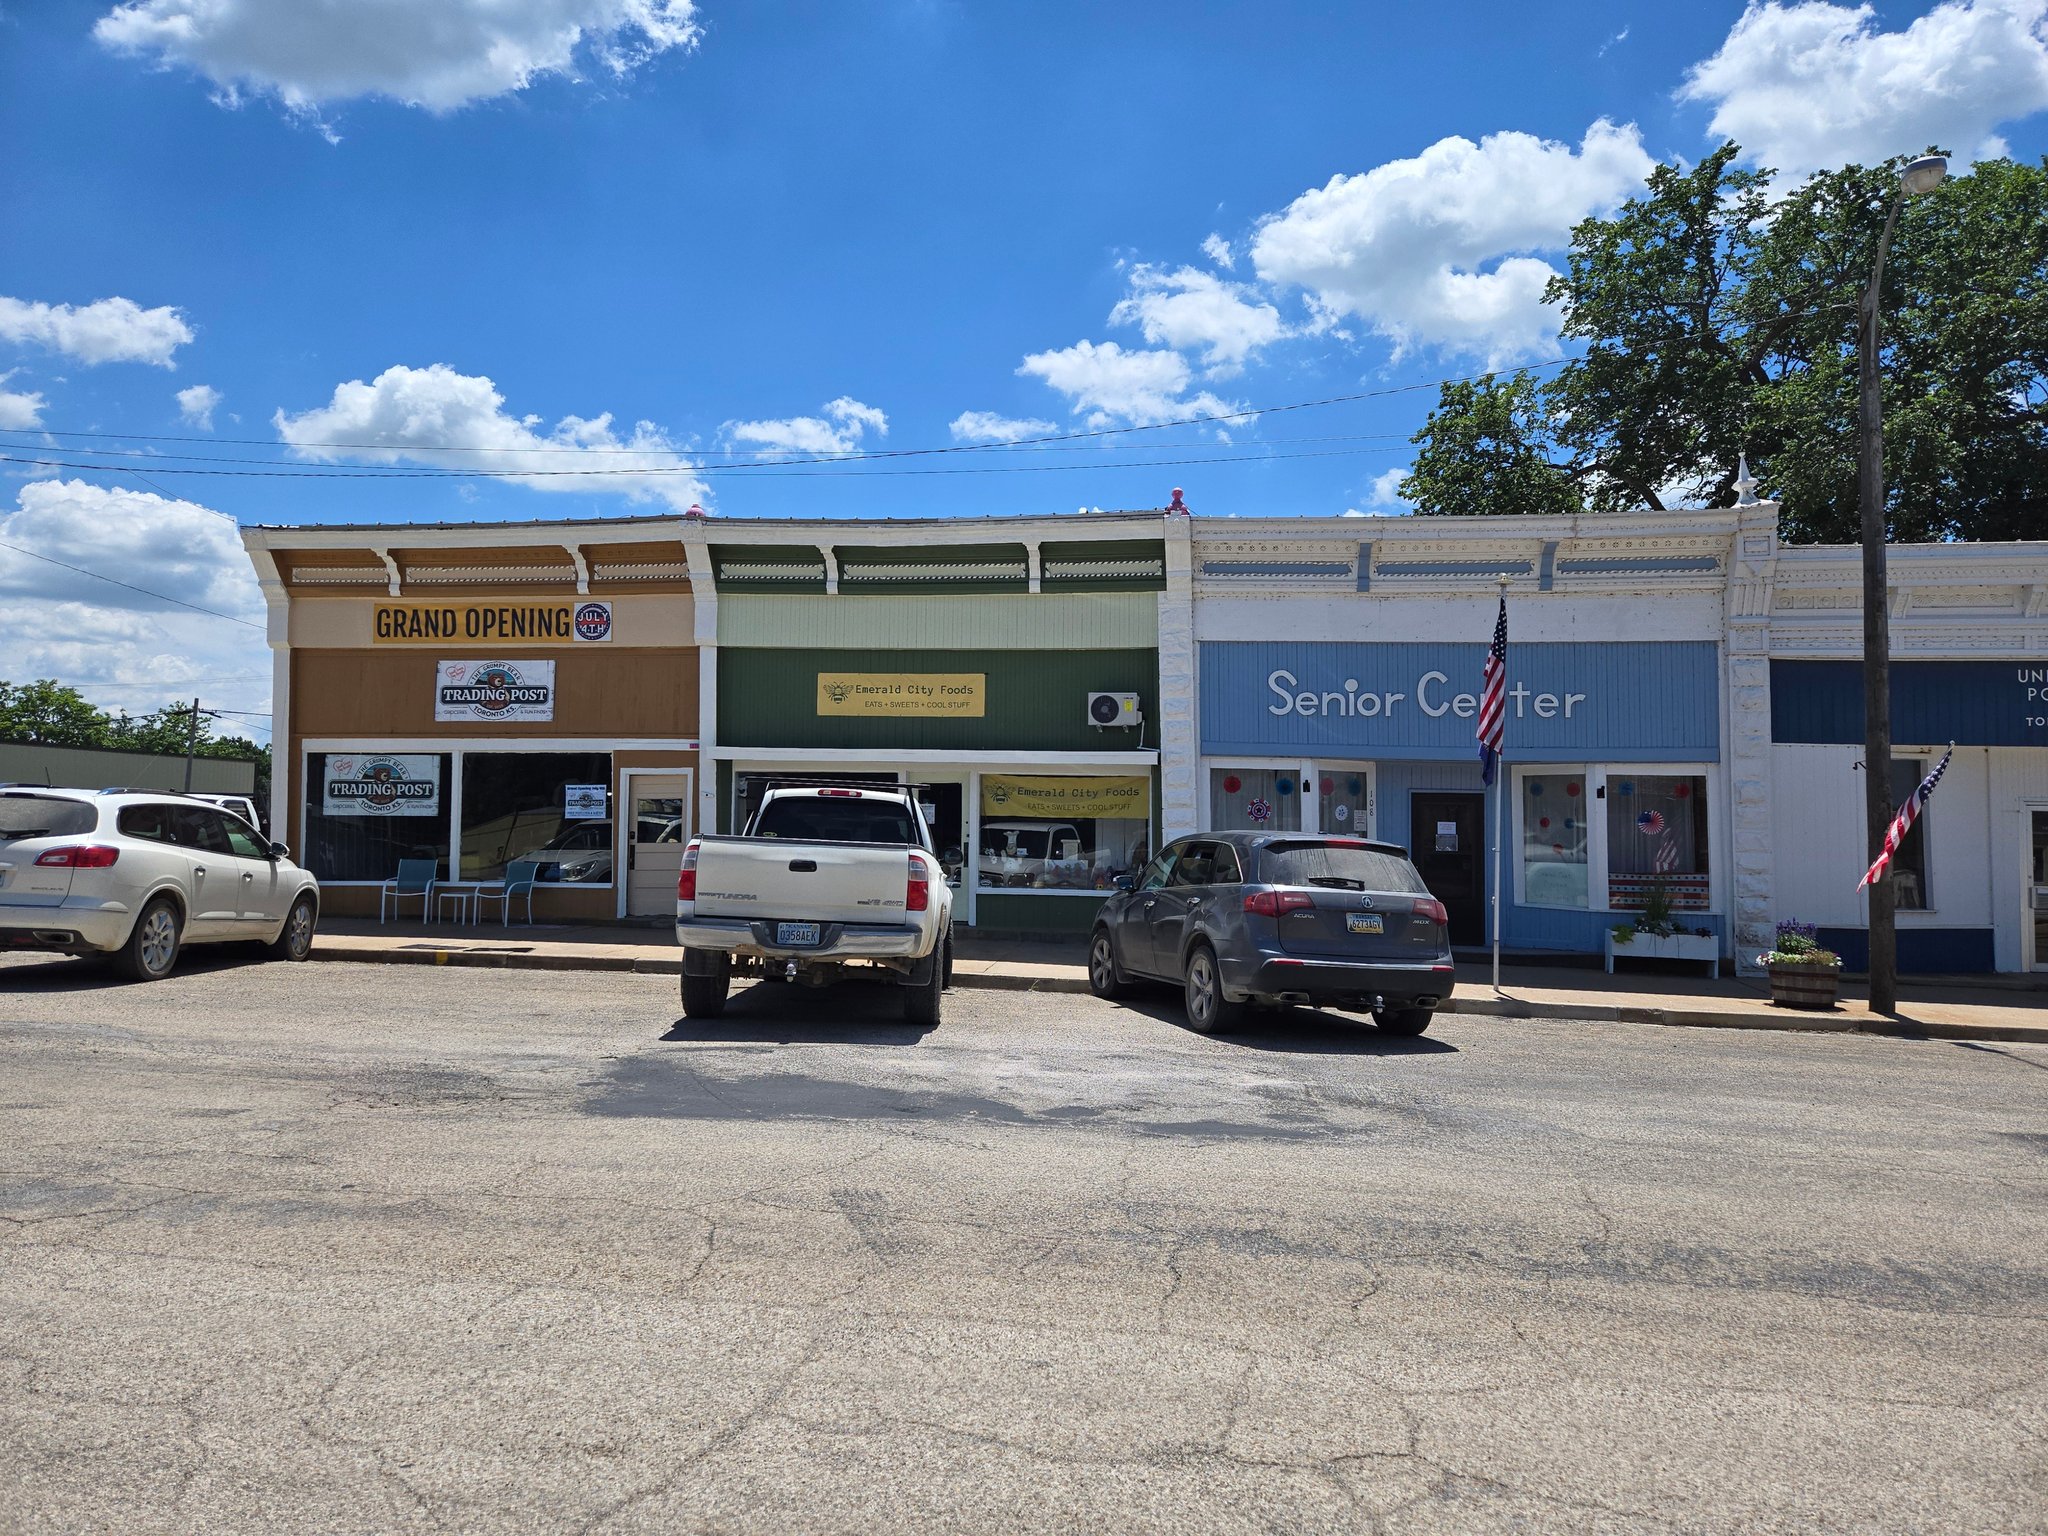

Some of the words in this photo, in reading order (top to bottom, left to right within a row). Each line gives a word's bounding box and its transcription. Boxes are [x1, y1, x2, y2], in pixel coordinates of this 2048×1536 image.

[377, 608, 457, 638] GRAND
[465, 608, 570, 638] OPENING
[577, 612, 608, 622] JULY
[472, 670, 482, 681] THE
[483, 663, 506, 671] GRUMPY
[507, 666, 521, 681] BEAR
[443, 689, 506, 701] TRADING
[510, 689, 547, 701] POST
[855, 684, 901, 694] Emerald
[907, 685, 934, 697] City
[940, 685, 974, 695] Foods
[1268, 670, 1406, 717] Senior
[473, 705, 505, 718] TORONTO
[926, 701, 946, 709] COOL
[947, 701, 971, 709] STUFF
[358, 764, 368, 776] THE
[392, 761, 406, 776] BEAR
[332, 783, 391, 796] TRADING
[396, 783, 433, 796] POST
[1017, 786, 1065, 798] Emerald
[1071, 788, 1098, 799] City
[1105, 787, 1140, 797] Foods
[360, 800, 391, 812] TORONTO
[1107, 803, 1132, 811] STUFF
[716, 893, 758, 901] TUNDRA
